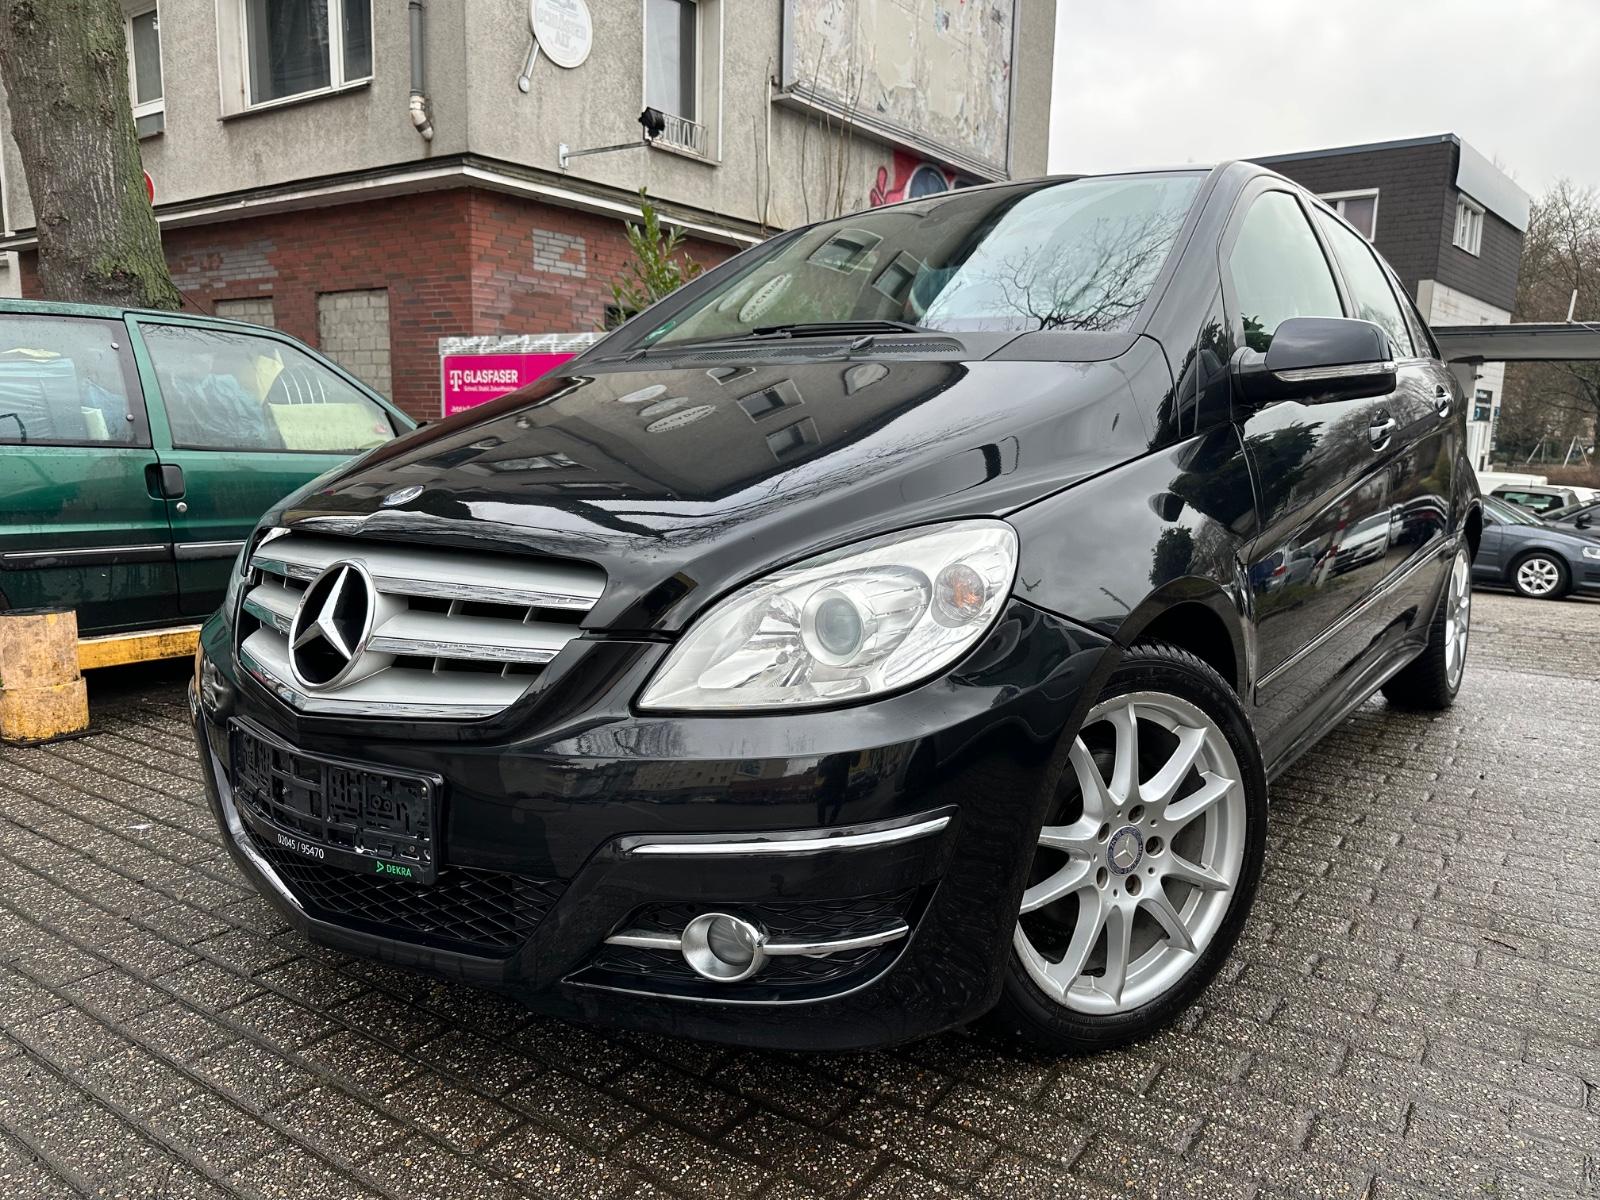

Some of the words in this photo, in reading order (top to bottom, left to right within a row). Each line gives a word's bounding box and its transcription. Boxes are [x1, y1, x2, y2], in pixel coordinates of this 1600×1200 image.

[464, 369, 518, 384] GLASFASER
[277, 833, 296, 849] 02045
[301, 842, 325, 860] 95470
[386, 863, 412, 877] DEKRA
